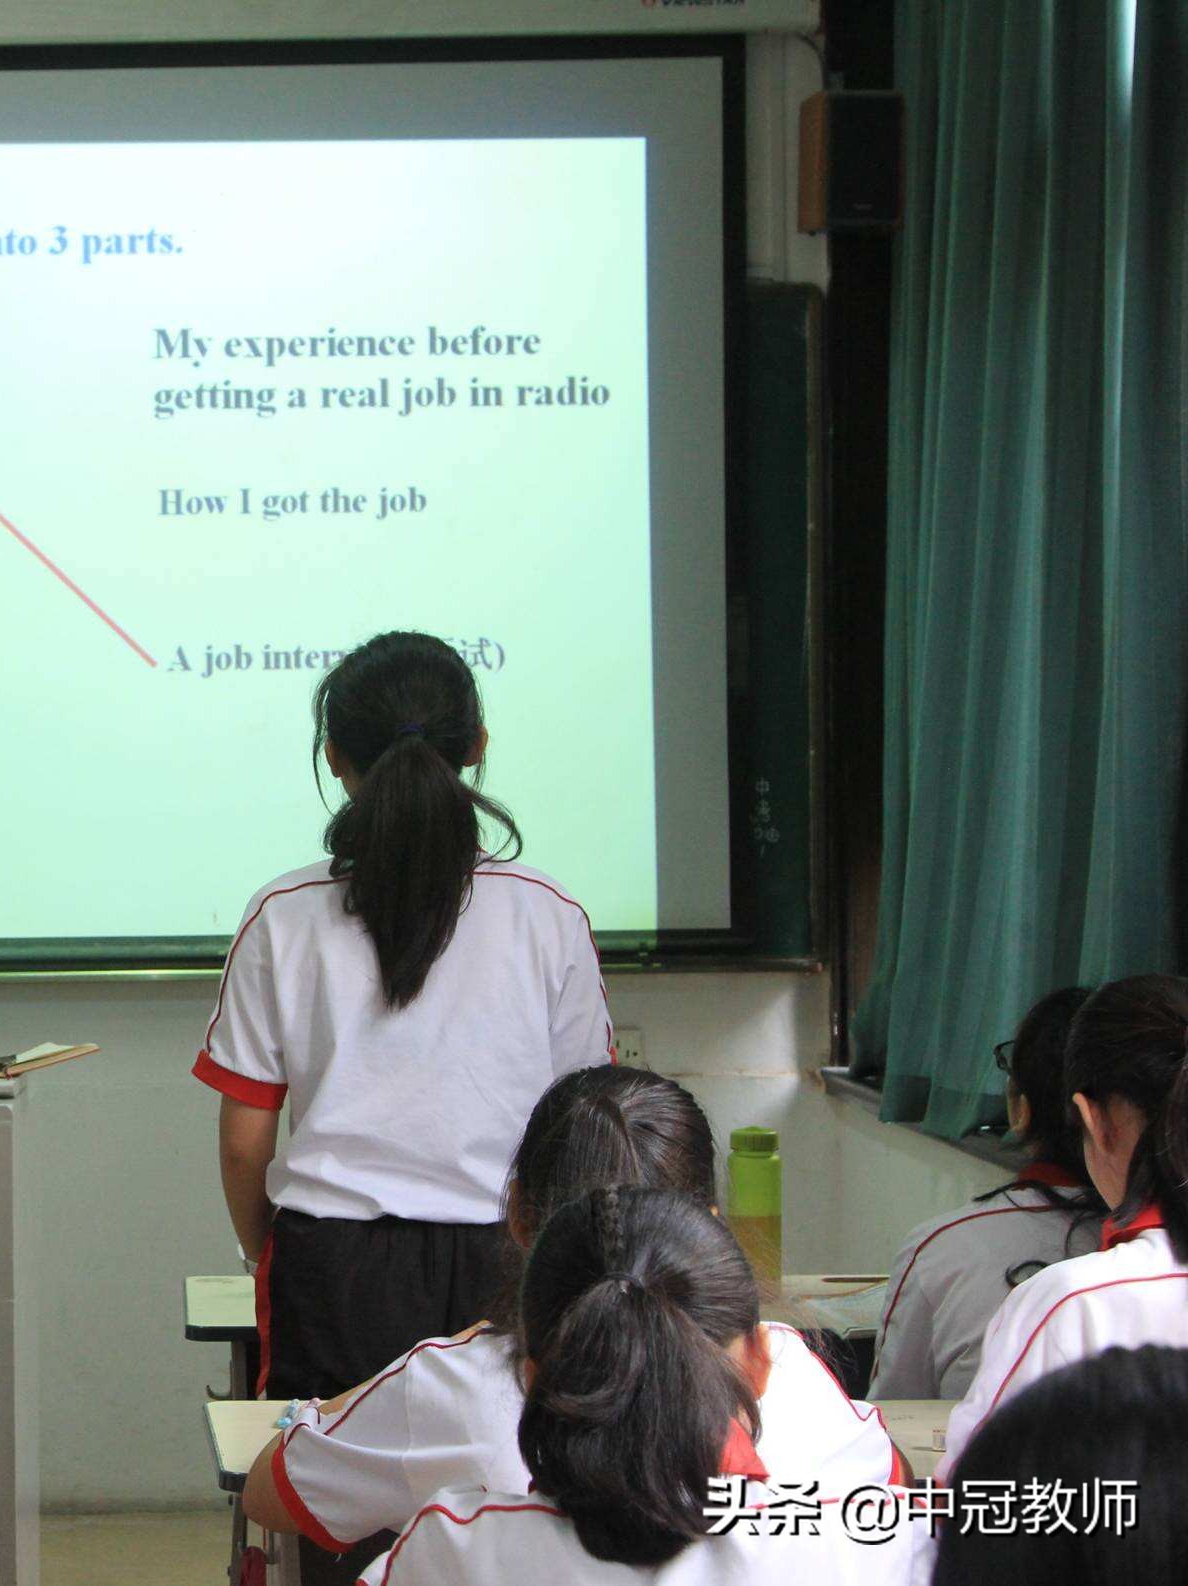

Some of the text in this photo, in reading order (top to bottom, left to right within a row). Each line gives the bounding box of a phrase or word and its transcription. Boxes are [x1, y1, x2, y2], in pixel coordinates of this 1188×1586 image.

[48, 226, 69, 256] 3
[81, 227, 185, 265] parts.
[152, 326, 541, 368] My experience before
[154, 376, 611, 420] getting a real job in radio
[158, 487, 428, 521] How I got the job
[167, 647, 193, 672] A
[202, 645, 253, 679] job
